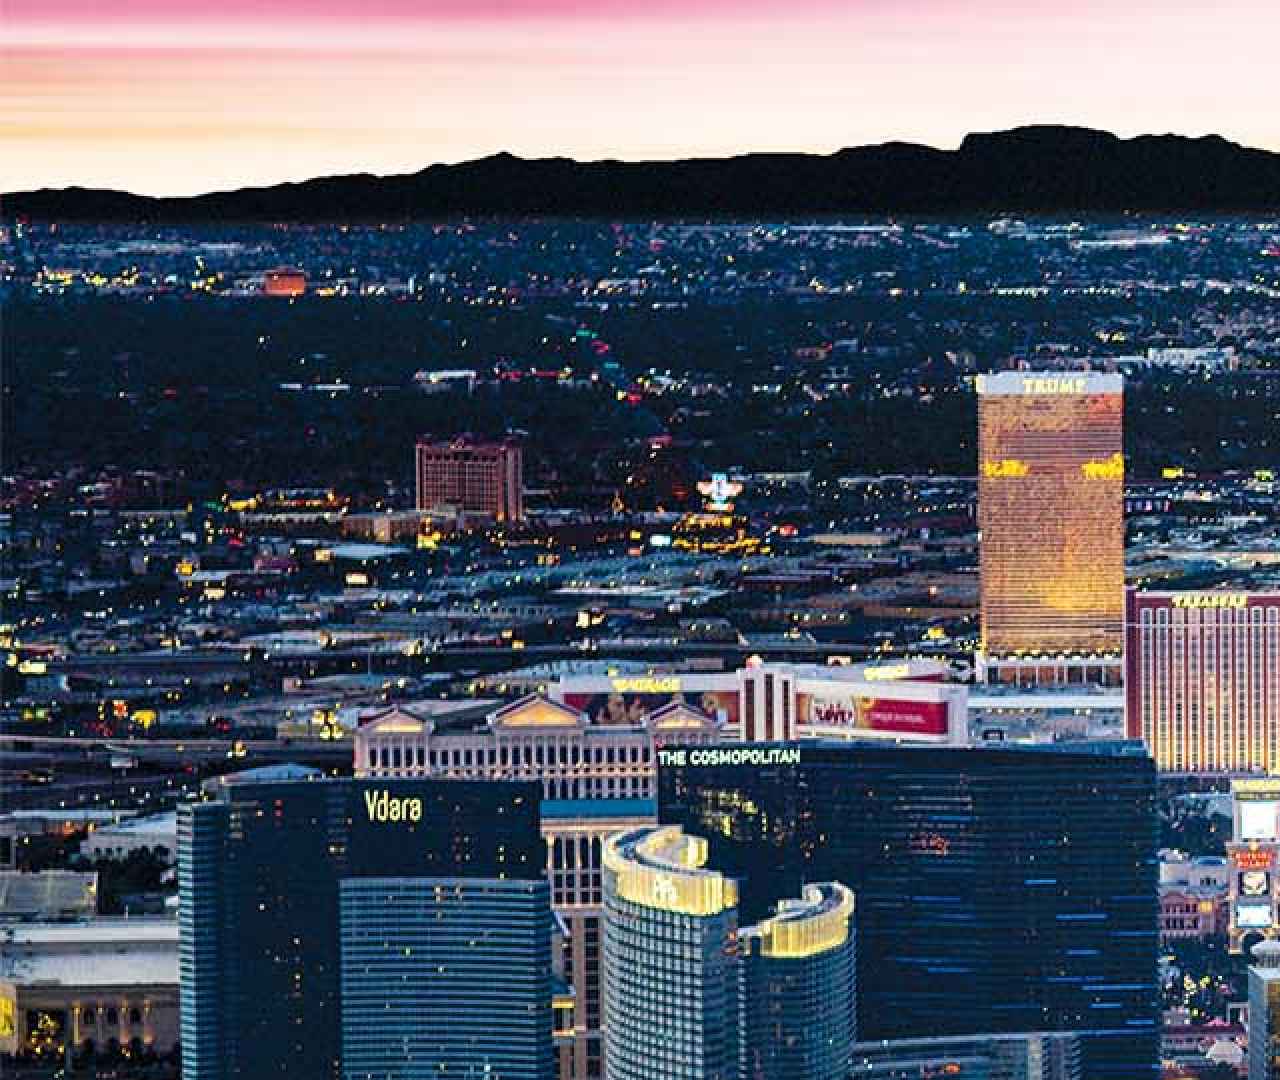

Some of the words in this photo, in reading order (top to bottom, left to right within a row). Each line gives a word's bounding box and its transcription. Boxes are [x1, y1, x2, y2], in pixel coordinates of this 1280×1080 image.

[1022, 378, 1087, 394] TRUMP
[1171, 592, 1248, 609] TREASURE
[658, 750, 687, 766] THE
[690, 749, 801, 766] COSMOPOLITAN
[363, 789, 422, 822] Vdara
